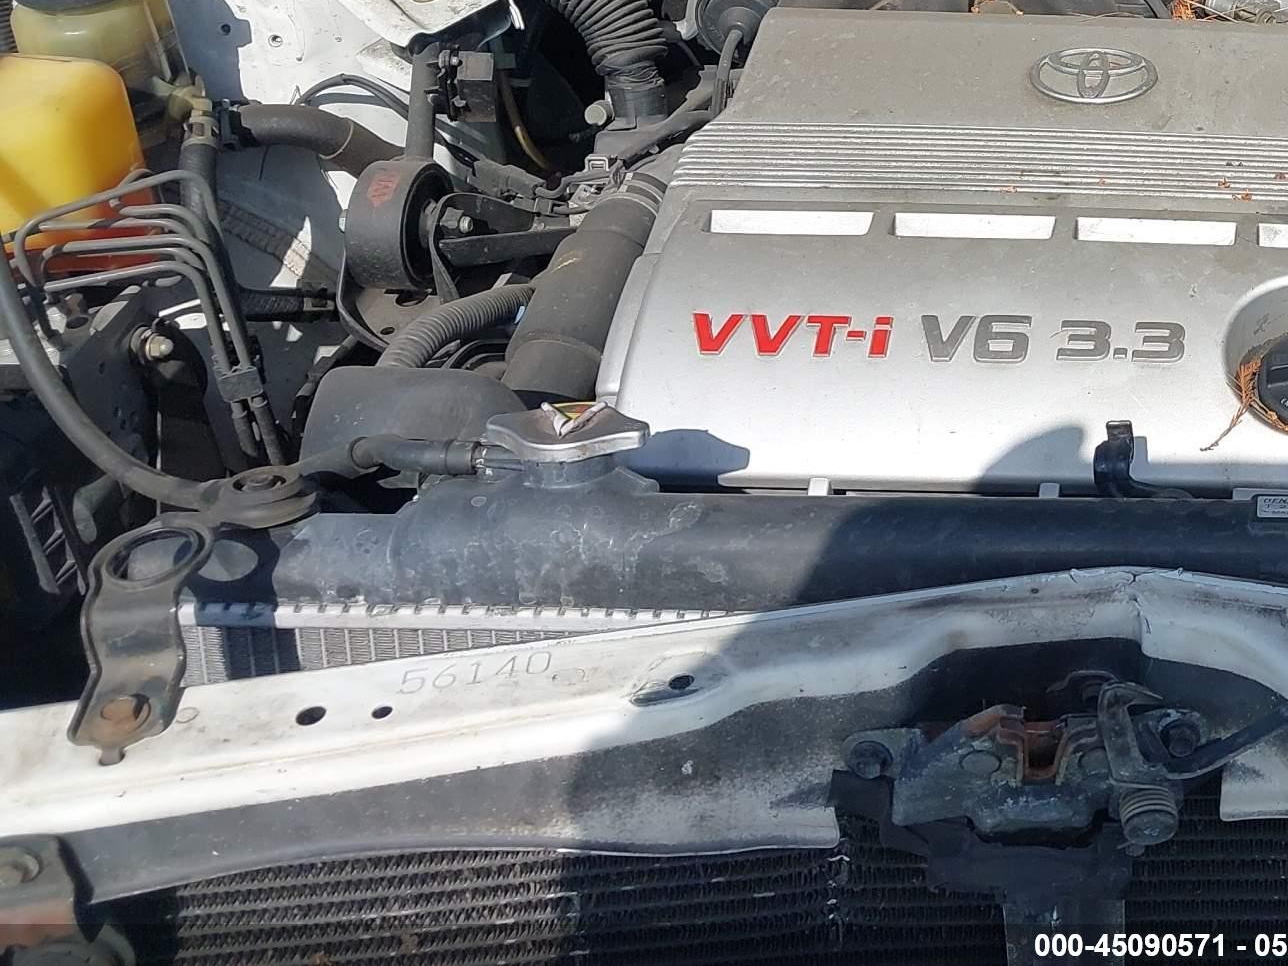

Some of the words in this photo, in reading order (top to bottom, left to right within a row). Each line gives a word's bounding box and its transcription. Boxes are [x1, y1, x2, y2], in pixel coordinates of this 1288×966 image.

[692, 312, 894, 358] VVT-i
[920, 314, 1033, 364] V6
[1055, 320, 1186, 364] 3.3
[395, 650, 553, 695] 56140
